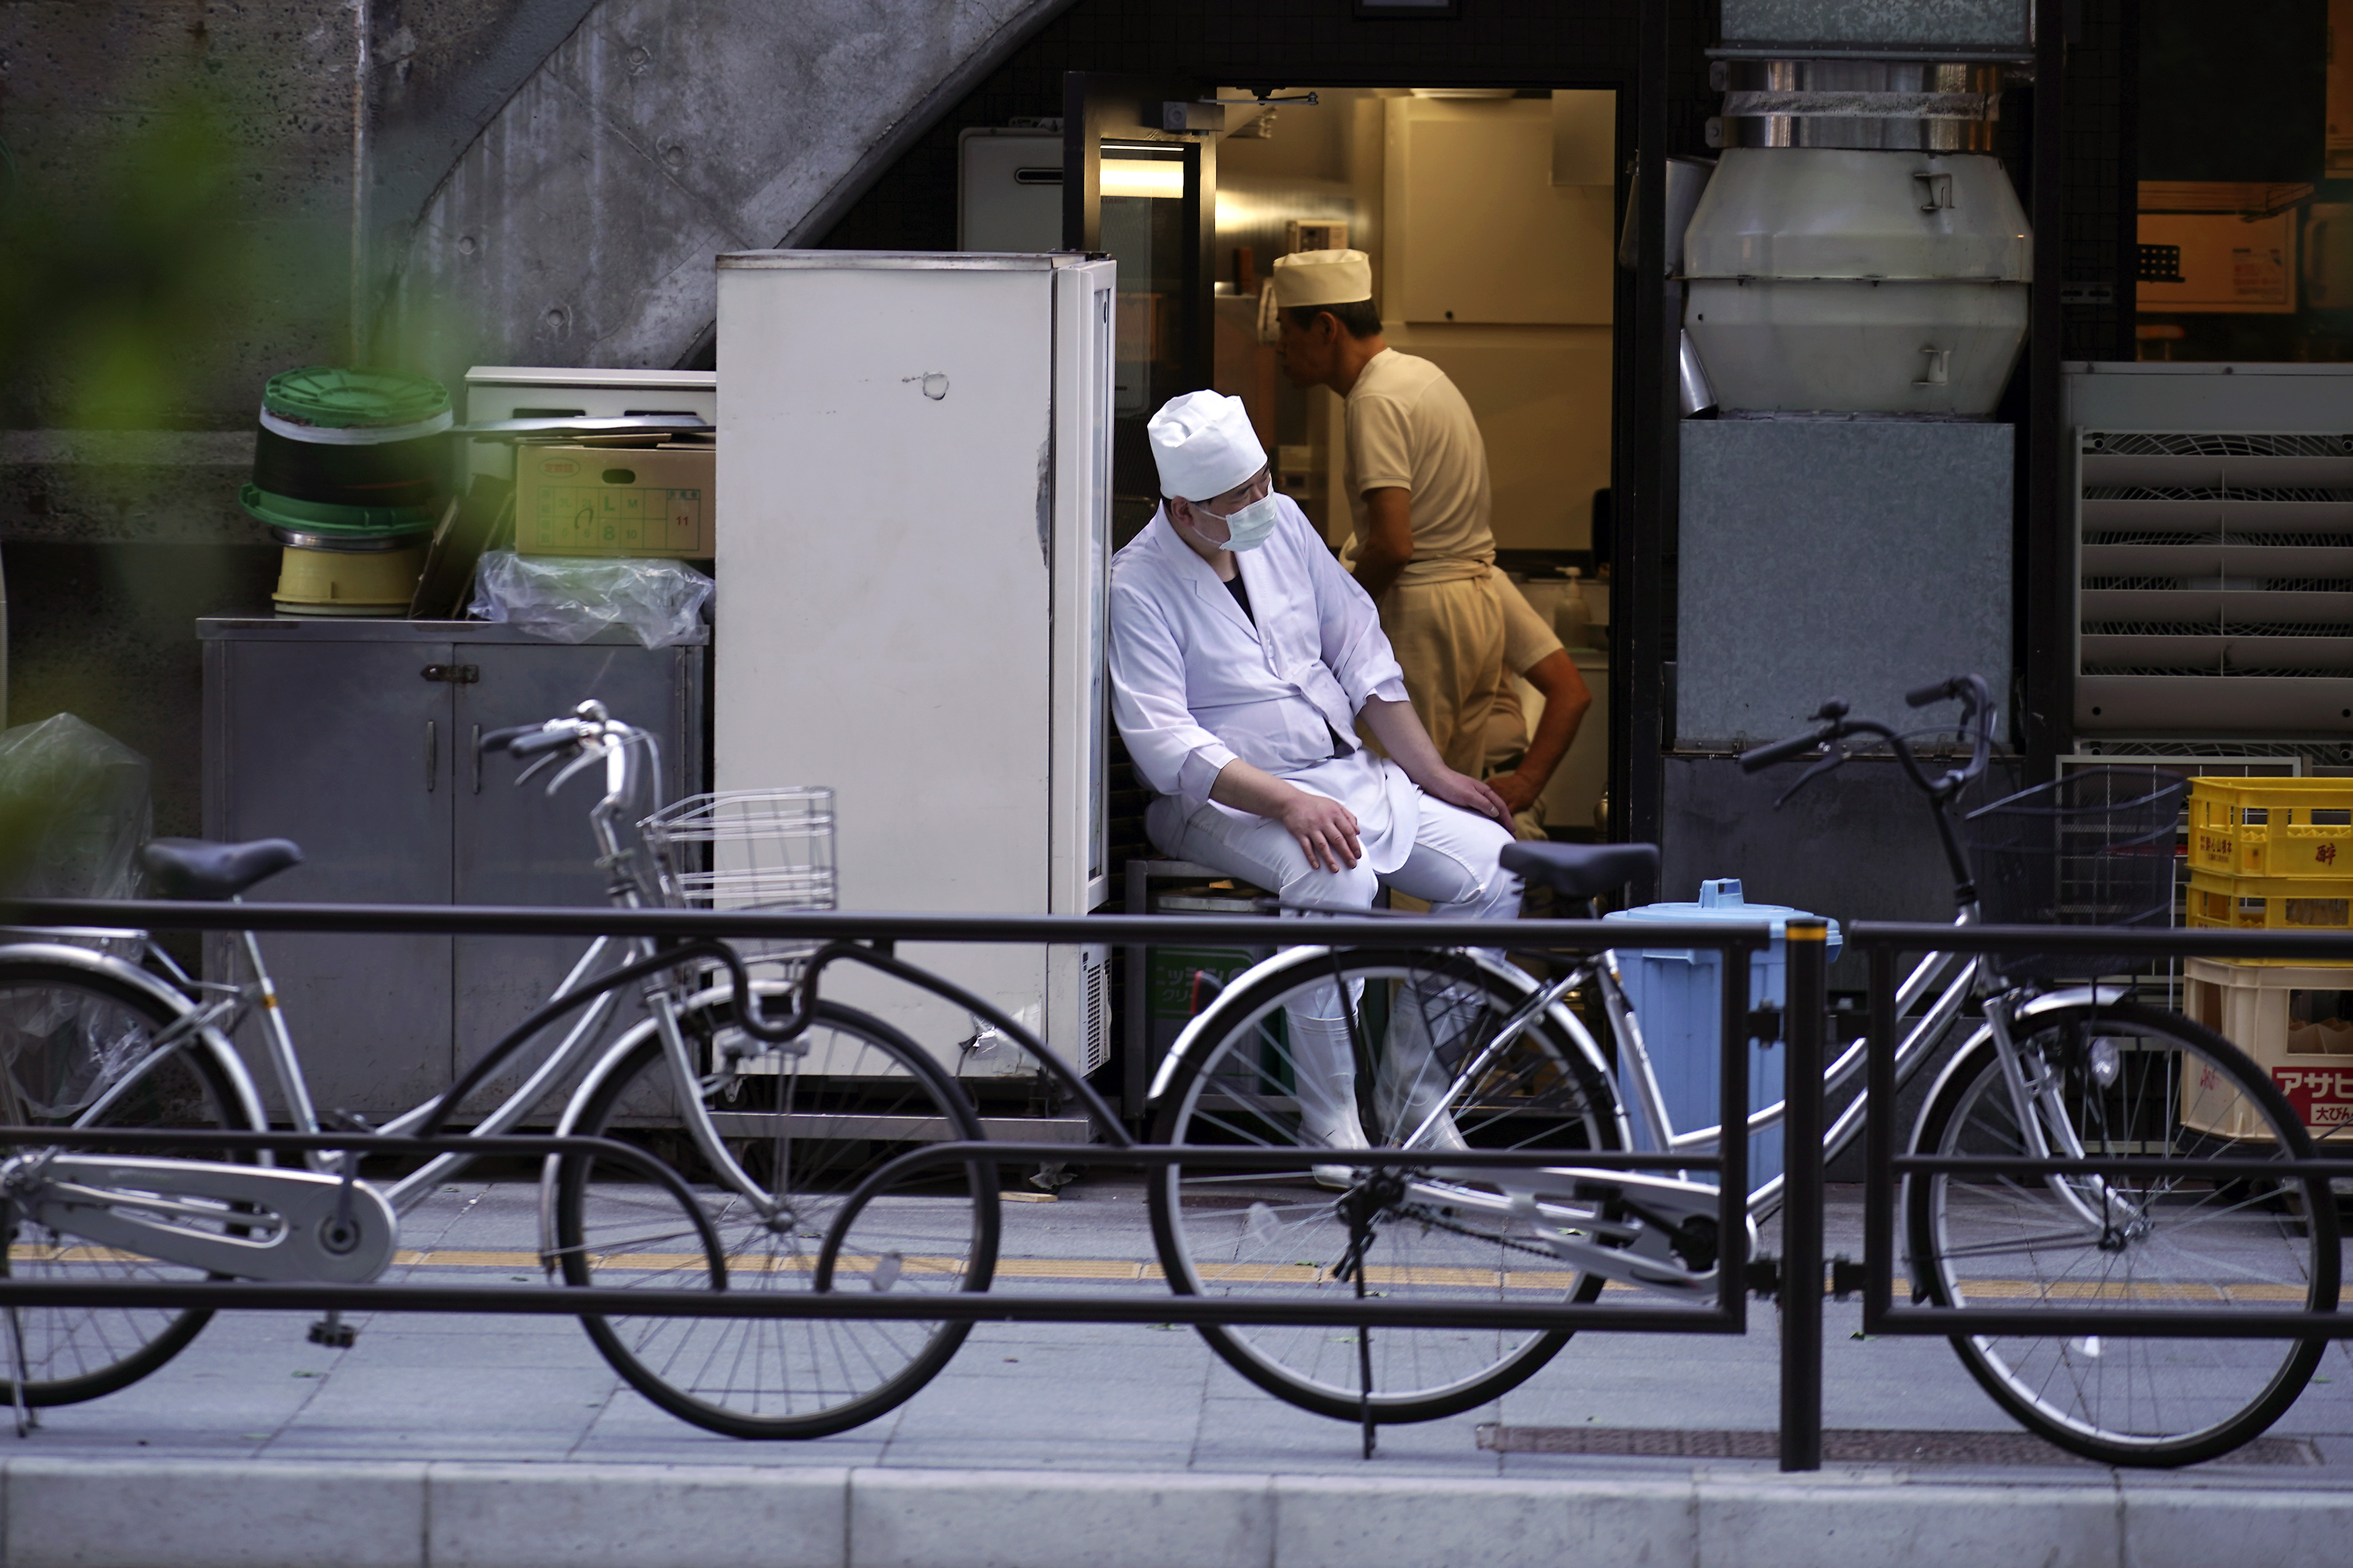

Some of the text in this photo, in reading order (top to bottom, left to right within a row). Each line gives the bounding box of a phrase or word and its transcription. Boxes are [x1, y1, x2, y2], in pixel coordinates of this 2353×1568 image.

[605, 496, 615, 510] L
[628, 499, 637, 508] M
[676, 516, 688, 525] 11
[604, 526, 615, 540] 8
[627, 530, 637, 539] 10
[1162, 989, 1194, 1002] クリ
[2276, 1073, 2353, 1098] アサヒ
[2316, 1106, 2352, 1121] 大びん
